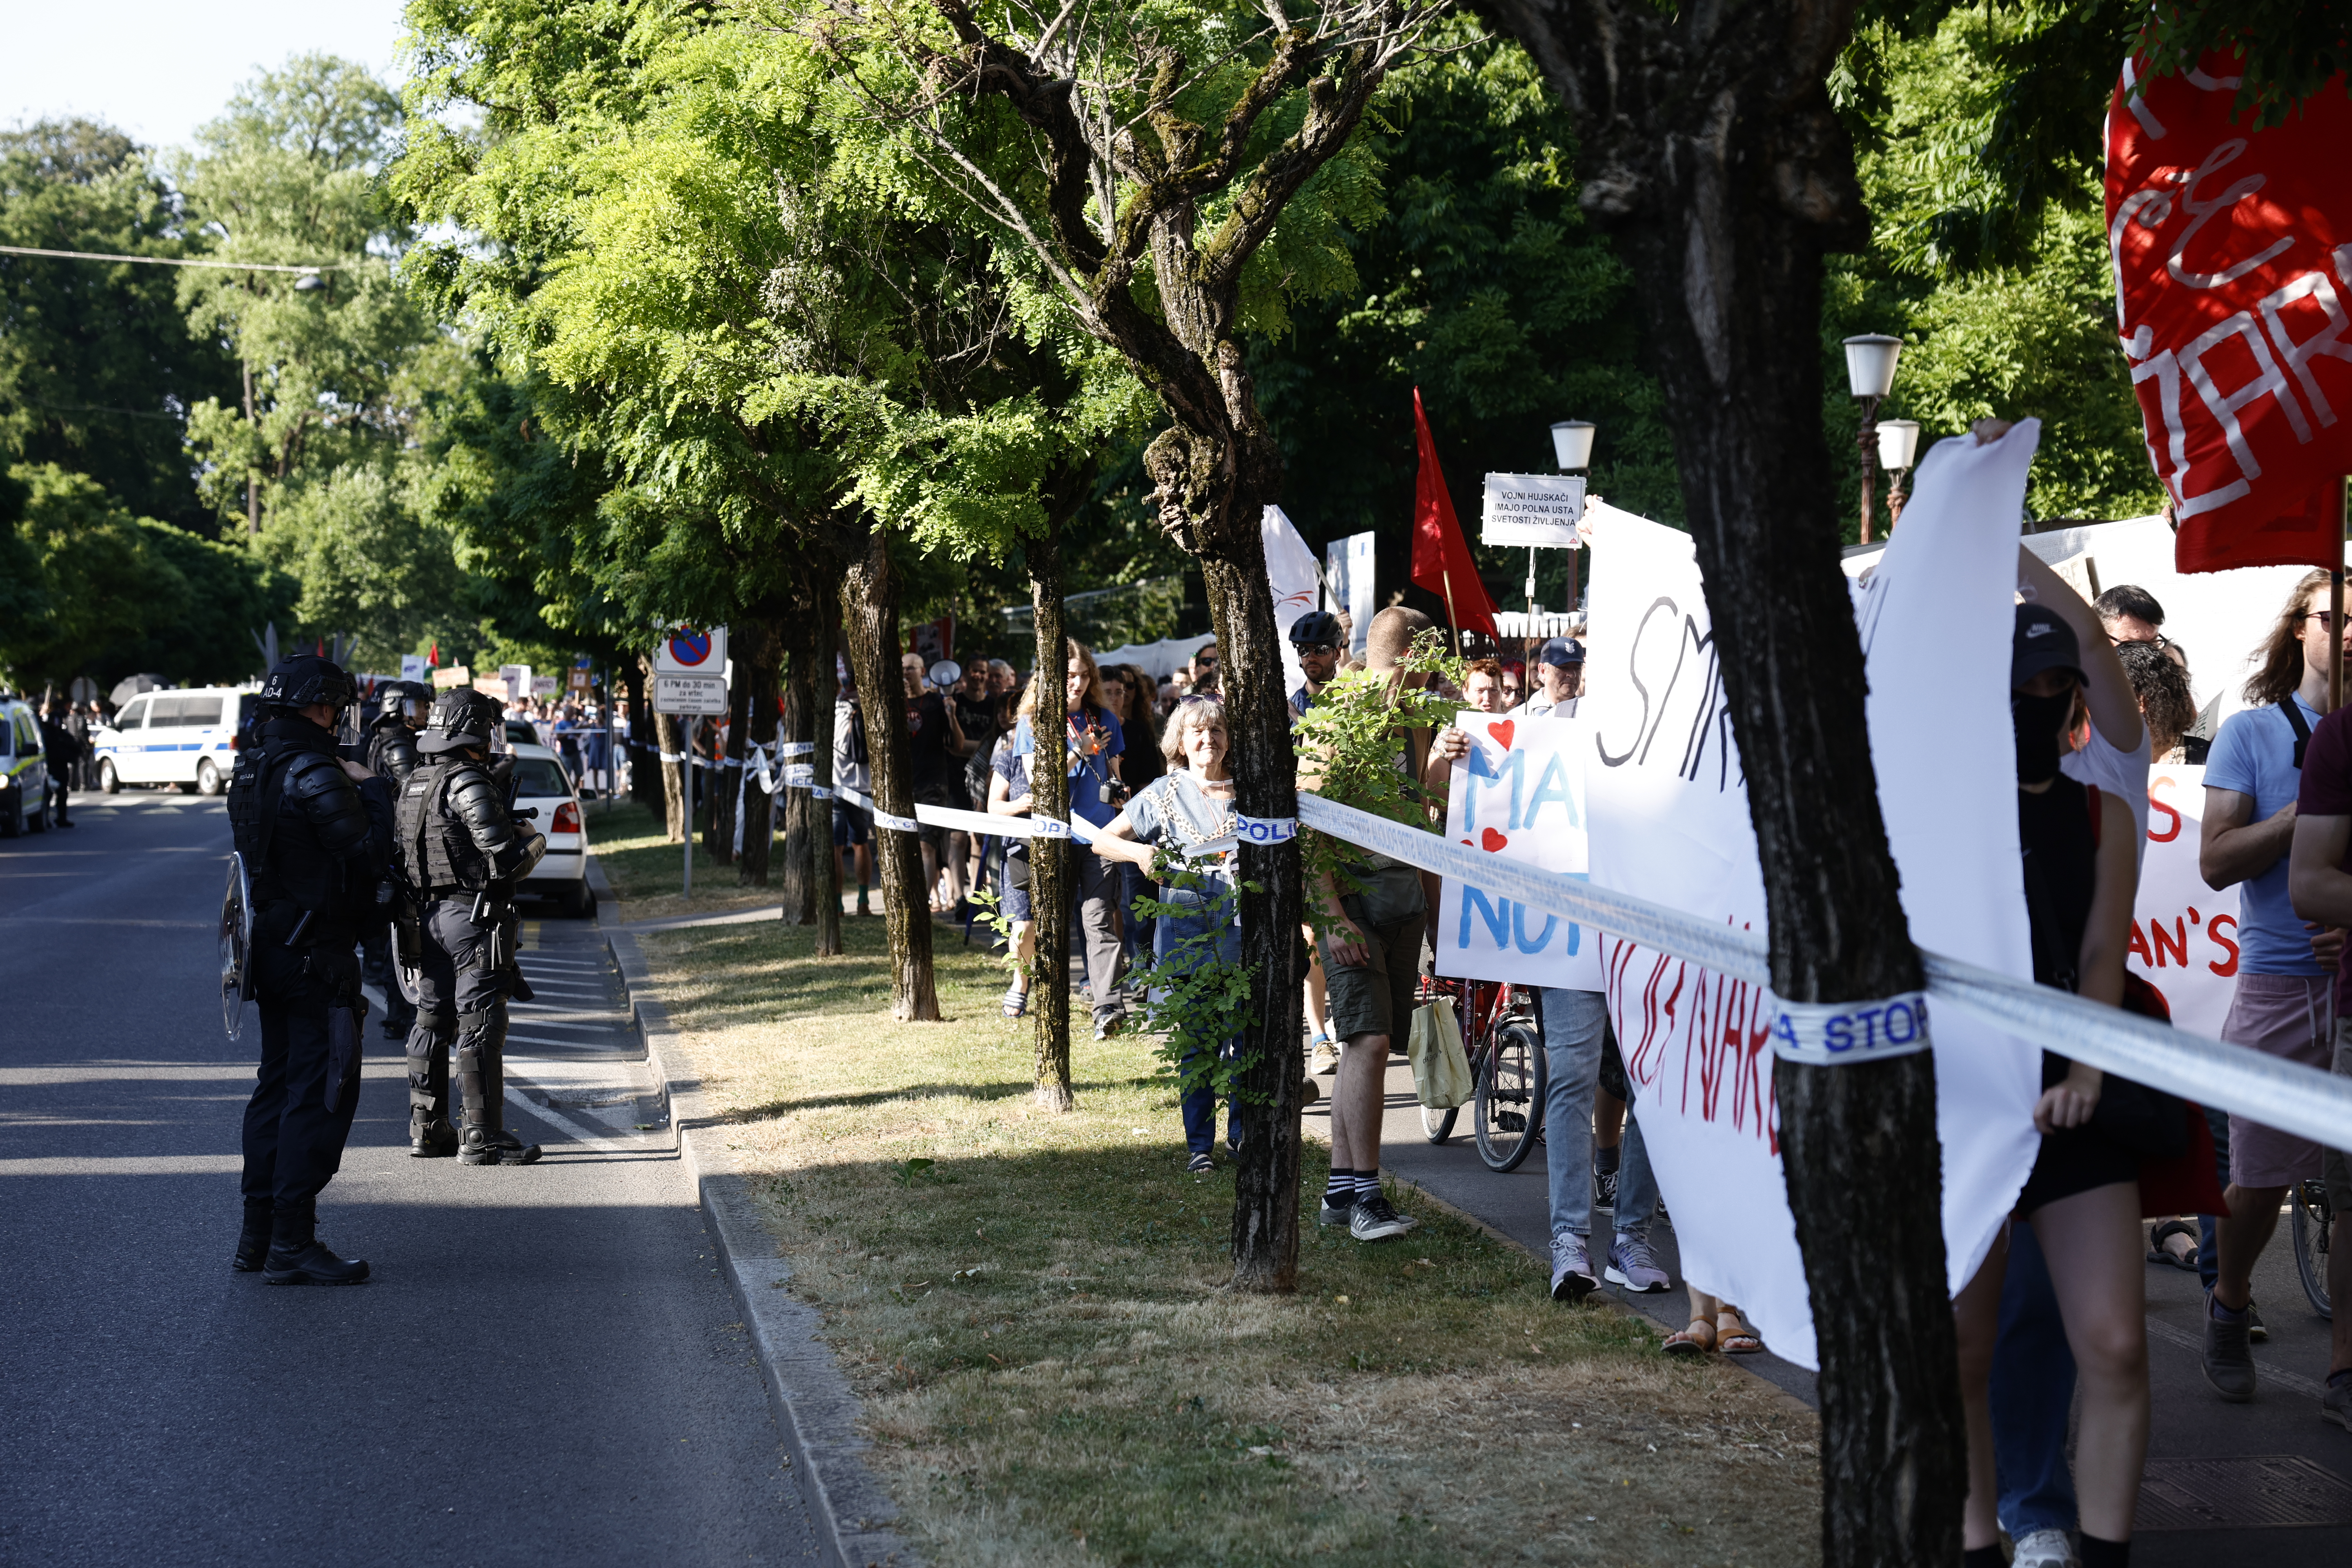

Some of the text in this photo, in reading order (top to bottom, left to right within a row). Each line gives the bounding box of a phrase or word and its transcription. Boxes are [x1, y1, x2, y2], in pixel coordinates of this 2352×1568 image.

[1502, 491, 1568, 502] VOJNI HUJSKAČI
[1495, 503, 1520, 512] IMAJO
[1552, 506, 1573, 514] USTA
[1492, 515, 1575, 526] SVETOSTI ŽIVLJENJA
[272, 675, 278, 686] 6
[263, 687, 282, 698] AD-4
[435, 706, 440, 715] 6
[429, 715, 444, 725] BB-5
